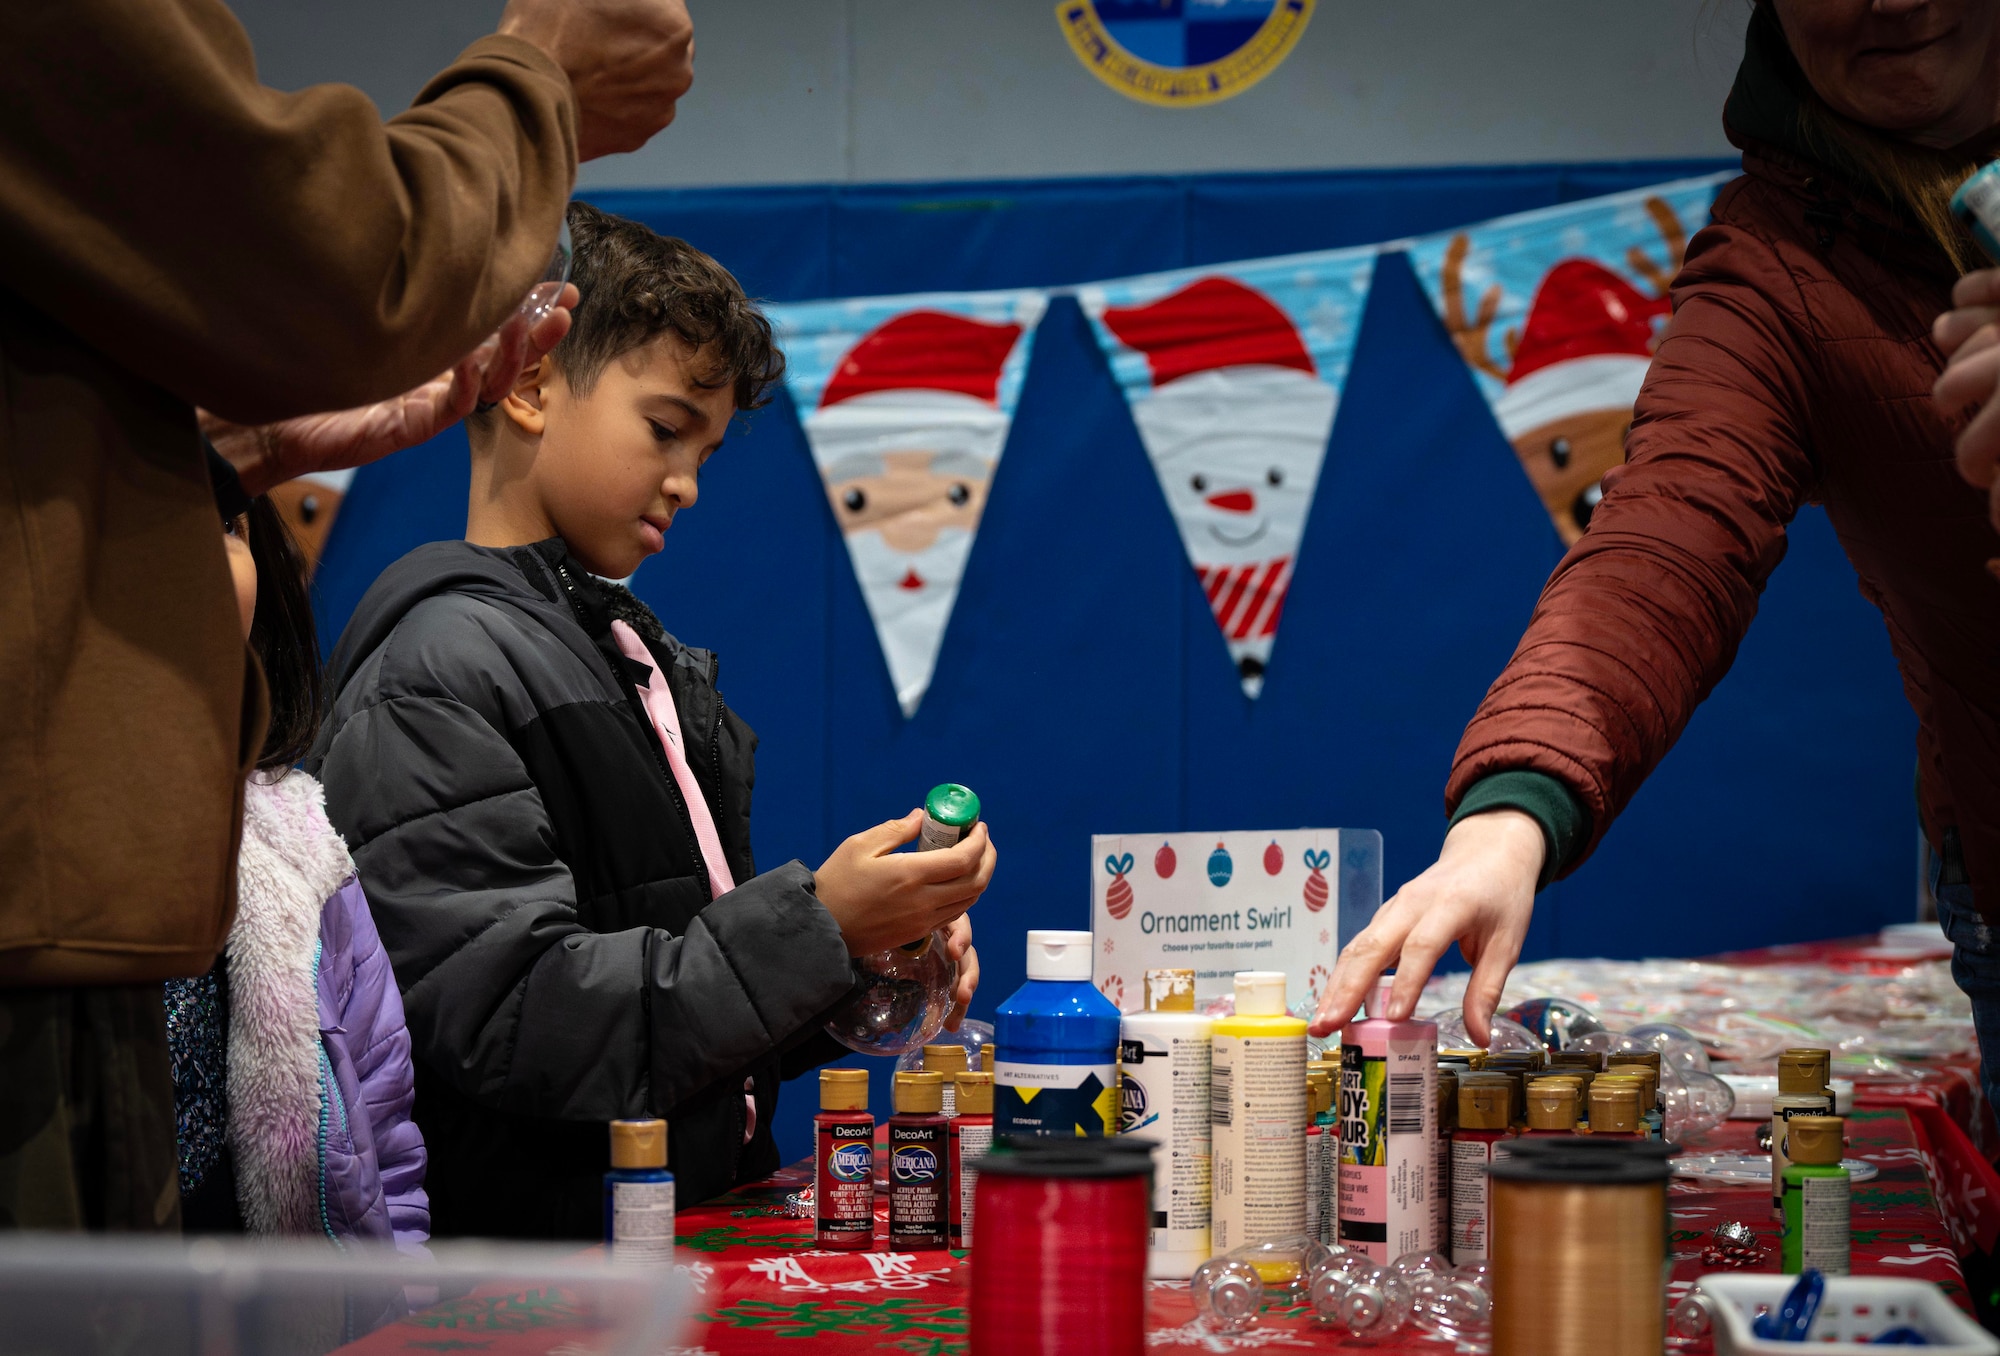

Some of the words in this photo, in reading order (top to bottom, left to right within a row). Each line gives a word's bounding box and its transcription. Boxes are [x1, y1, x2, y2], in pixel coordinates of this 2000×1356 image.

[1141, 911, 1240, 934] Ornament
[1247, 906, 1291, 930] Swirl
[1162, 944, 1189, 952] Choose
[1190, 944, 1206, 953] your
[1207, 940, 1235, 950] favorite
[1235, 940, 1253, 948] color
[1254, 939, 1273, 950] paint
[1197, 969, 1217, 979] inside
[1014, 1072, 1059, 1081] ALTERNATIVES
[1012, 1117, 1042, 1125] ECONOMY
[895, 1129, 933, 1140] DecoArt
[831, 1150, 872, 1170] AMERICAN
[892, 1151, 935, 1171] AMERICANA
